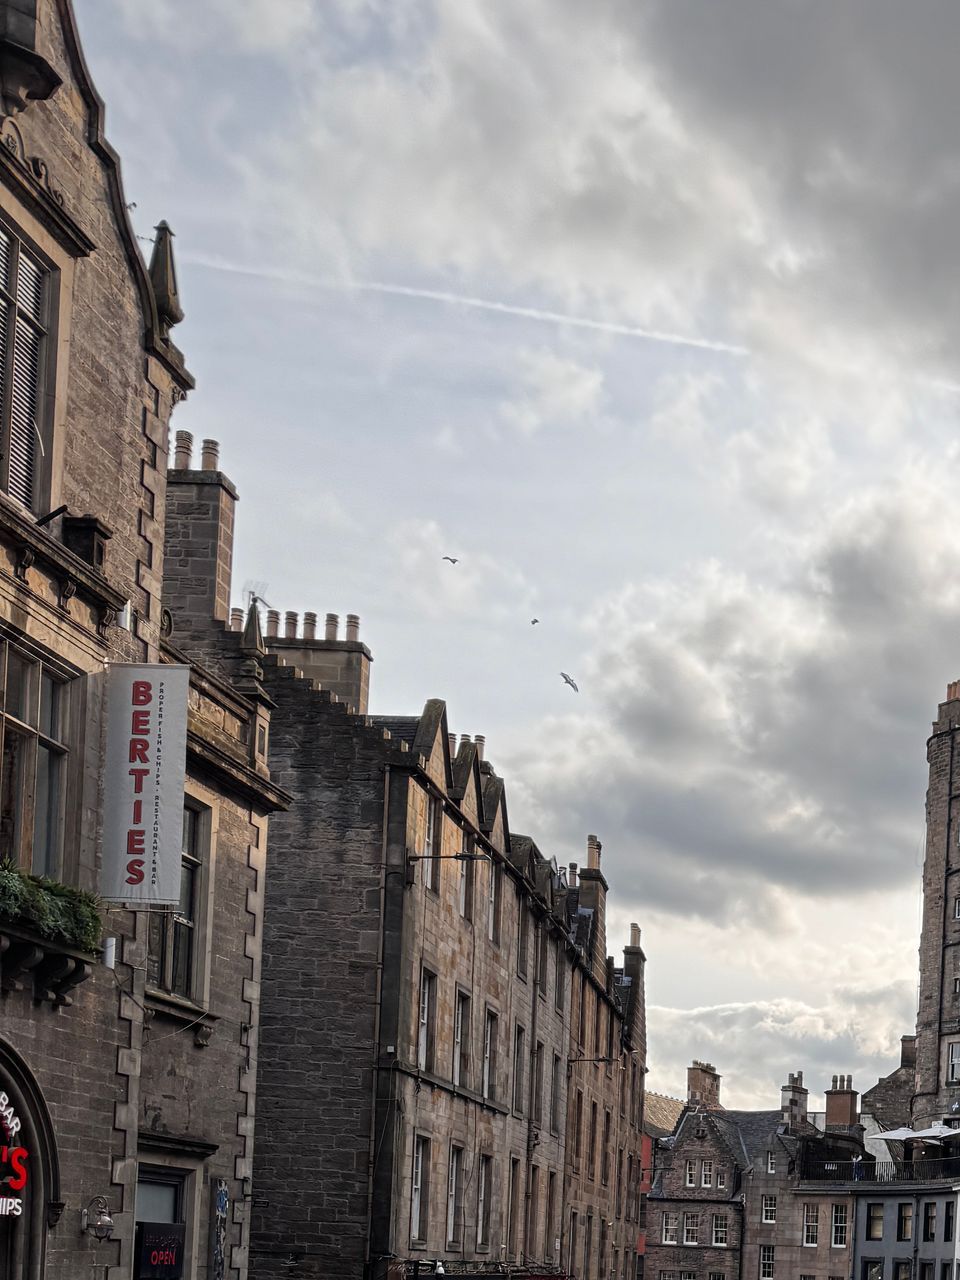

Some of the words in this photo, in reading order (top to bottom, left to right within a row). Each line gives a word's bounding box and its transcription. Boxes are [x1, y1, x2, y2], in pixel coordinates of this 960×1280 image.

[125, 681, 152, 885] BERTIES
[152, 795, 160, 857] RESTAURANT
[151, 1249, 176, 1265] OPEN
